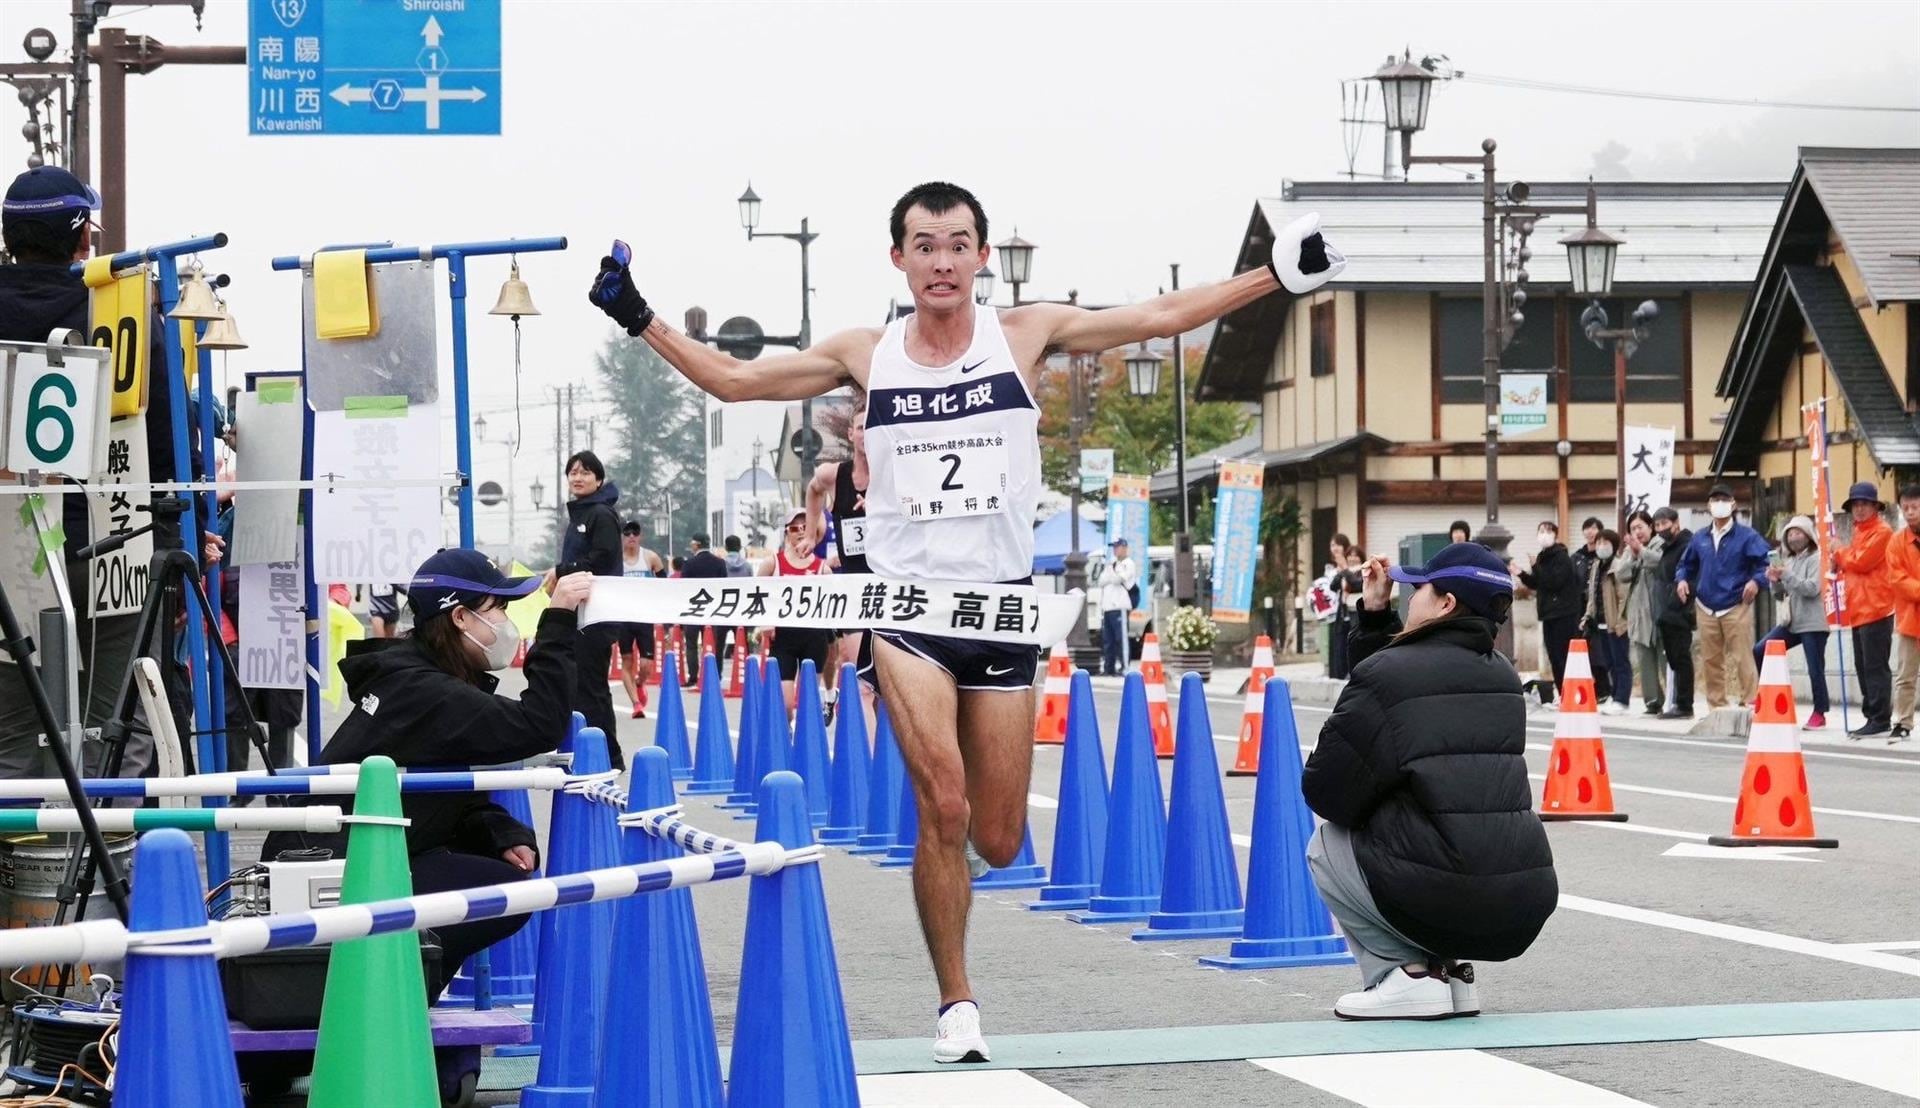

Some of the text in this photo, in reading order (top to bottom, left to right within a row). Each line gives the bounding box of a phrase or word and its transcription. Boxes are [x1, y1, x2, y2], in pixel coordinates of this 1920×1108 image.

[279, 0, 300, 19] 13
[403, 0, 465, 12] Shiroishi
[258, 36, 320, 64] 南陽
[428, 53, 438, 71] 1
[262, 66, 316, 82] Nan-yo
[259, 87, 321, 114] 川西
[381, 86, 393, 104] 7
[256, 116, 322, 131] Kawanishi
[892, 382, 994, 418] 旭化成
[25, 372, 77, 464] 6
[939, 453, 964, 491] 2
[853, 526, 864, 543] 3
[96, 555, 149, 611] 20km
[680, 586, 769, 619] 全日本
[778, 586, 848, 619] 35km
[858, 582, 929, 621] 競歩
